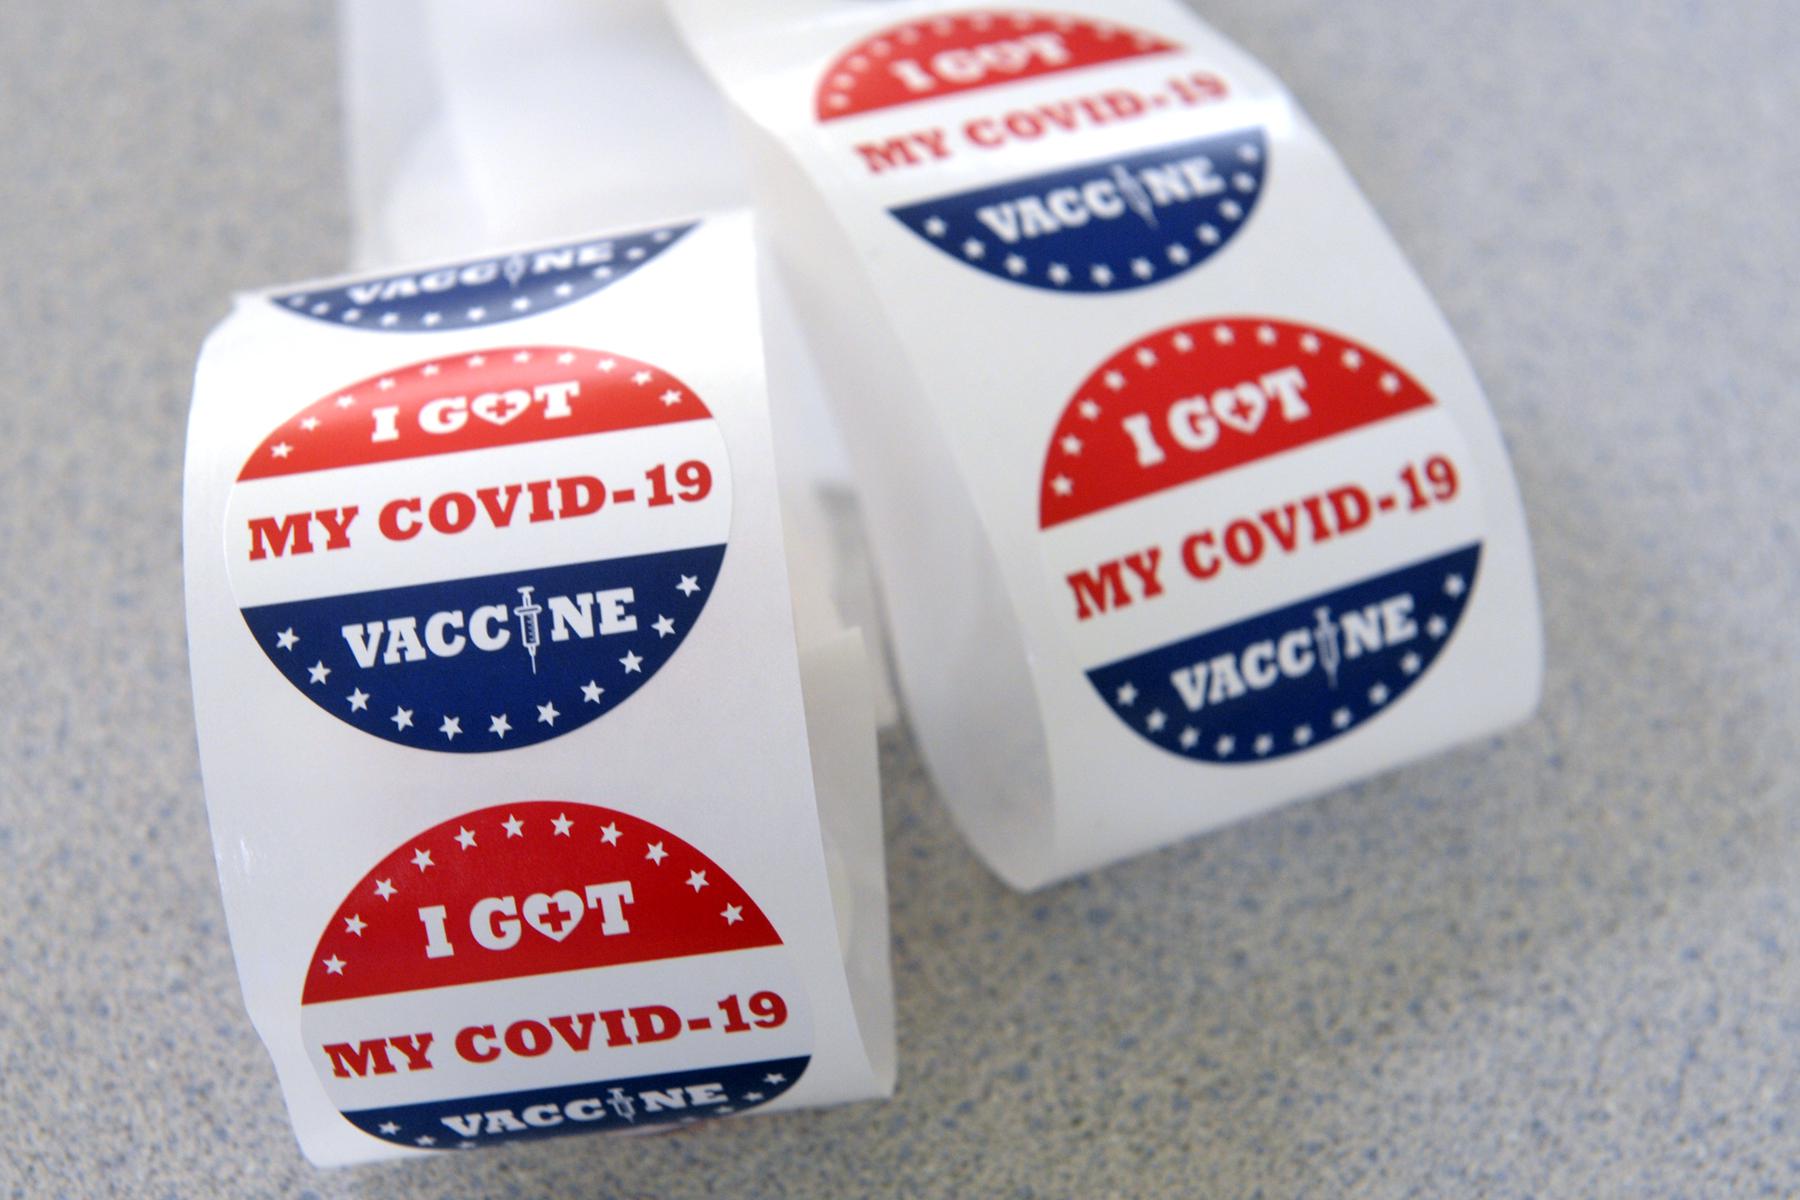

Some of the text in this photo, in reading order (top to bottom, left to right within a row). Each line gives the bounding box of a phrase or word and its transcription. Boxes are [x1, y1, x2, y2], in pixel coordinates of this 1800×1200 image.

[890, 59, 937, 92] I
[854, 72, 1230, 176] MY COVID-19
[976, 157, 1228, 245] VACCINE
[346, 240, 614, 305] VACCINE
[370, 406, 400, 443] I
[1122, 413, 1165, 468] I
[248, 460, 713, 562] MY COVID-19
[1066, 454, 1459, 622] MY COVID-19
[342, 586, 638, 675] VACCINE
[1170, 594, 1418, 712] VACCINE
[418, 904, 455, 959] I
[322, 990, 788, 1080] MY COVID-19
[442, 1082, 729, 1138] VACCINE
